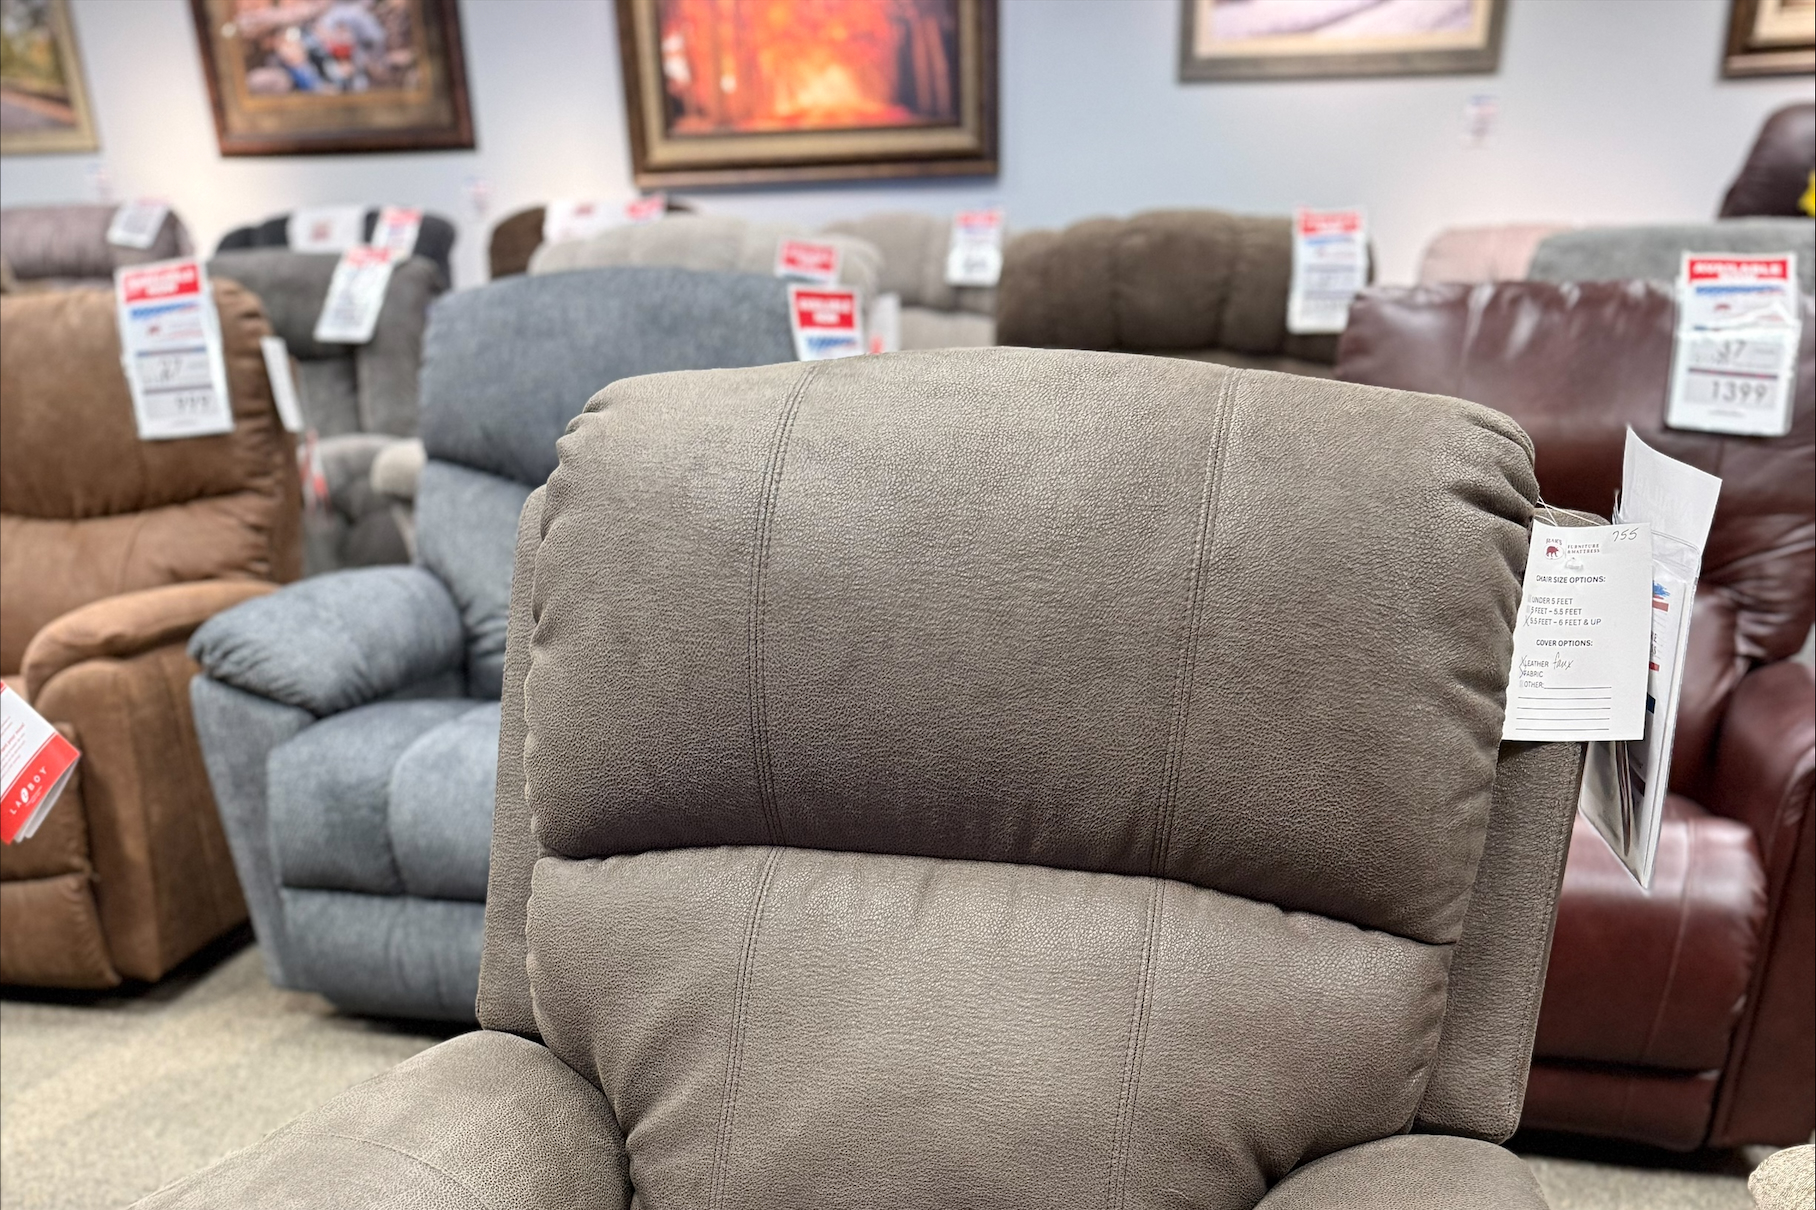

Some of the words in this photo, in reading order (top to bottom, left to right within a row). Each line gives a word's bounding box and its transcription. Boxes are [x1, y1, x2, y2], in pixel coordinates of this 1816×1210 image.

[1711, 380, 1768, 403] 1399
[1536, 575, 1552, 583] CHAIR
[1553, 576, 1568, 584] SIZE
[1569, 575, 1606, 584] OPTIONS:
[1531, 596, 1550, 605] UNDER
[1556, 597, 1573, 605] FEET
[1535, 607, 1548, 615] FEET
[1553, 608, 1564, 616] 5.5
[1565, 608, 1582, 616] FEET
[1538, 618, 1552, 626] FEET
[1583, 618, 1589, 626] &
[1590, 618, 1602, 626] UP
[1536, 639, 1557, 647] COVER
[1558, 639, 1593, 647] OPTIONS:
[1524, 660, 1549, 668] LEATHER
[1524, 670, 1543, 678] FABRIC
